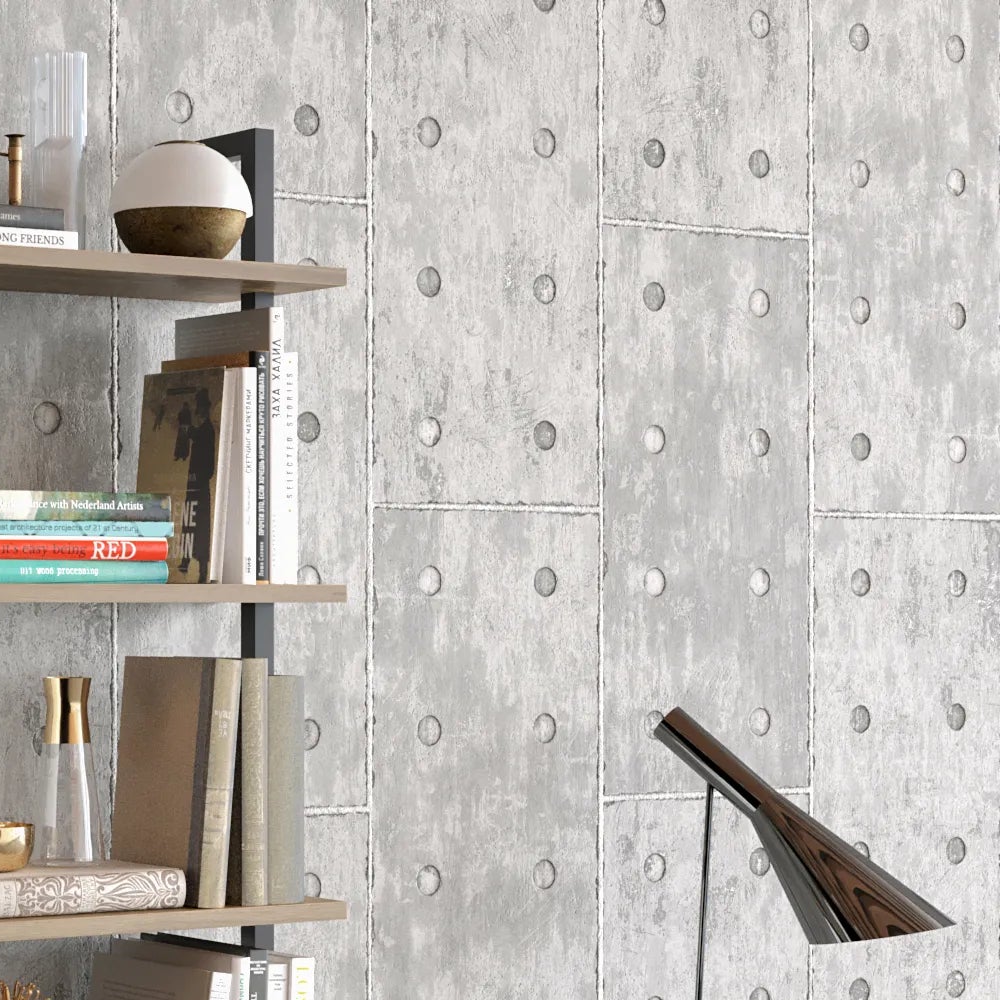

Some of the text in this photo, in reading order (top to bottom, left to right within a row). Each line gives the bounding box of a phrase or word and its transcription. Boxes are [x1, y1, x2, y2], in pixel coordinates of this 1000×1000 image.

[20, 233, 65, 246] FRIENDS
[286, 373, 294, 427] STORIES
[49, 500, 70, 510] with
[71, 500, 116, 510] Nederland
[117, 501, 144, 511] Artists
[54, 524, 83, 533] projects
[22, 545, 48, 557] easy
[53, 543, 88, 558] being
[90, 541, 137, 560] RED
